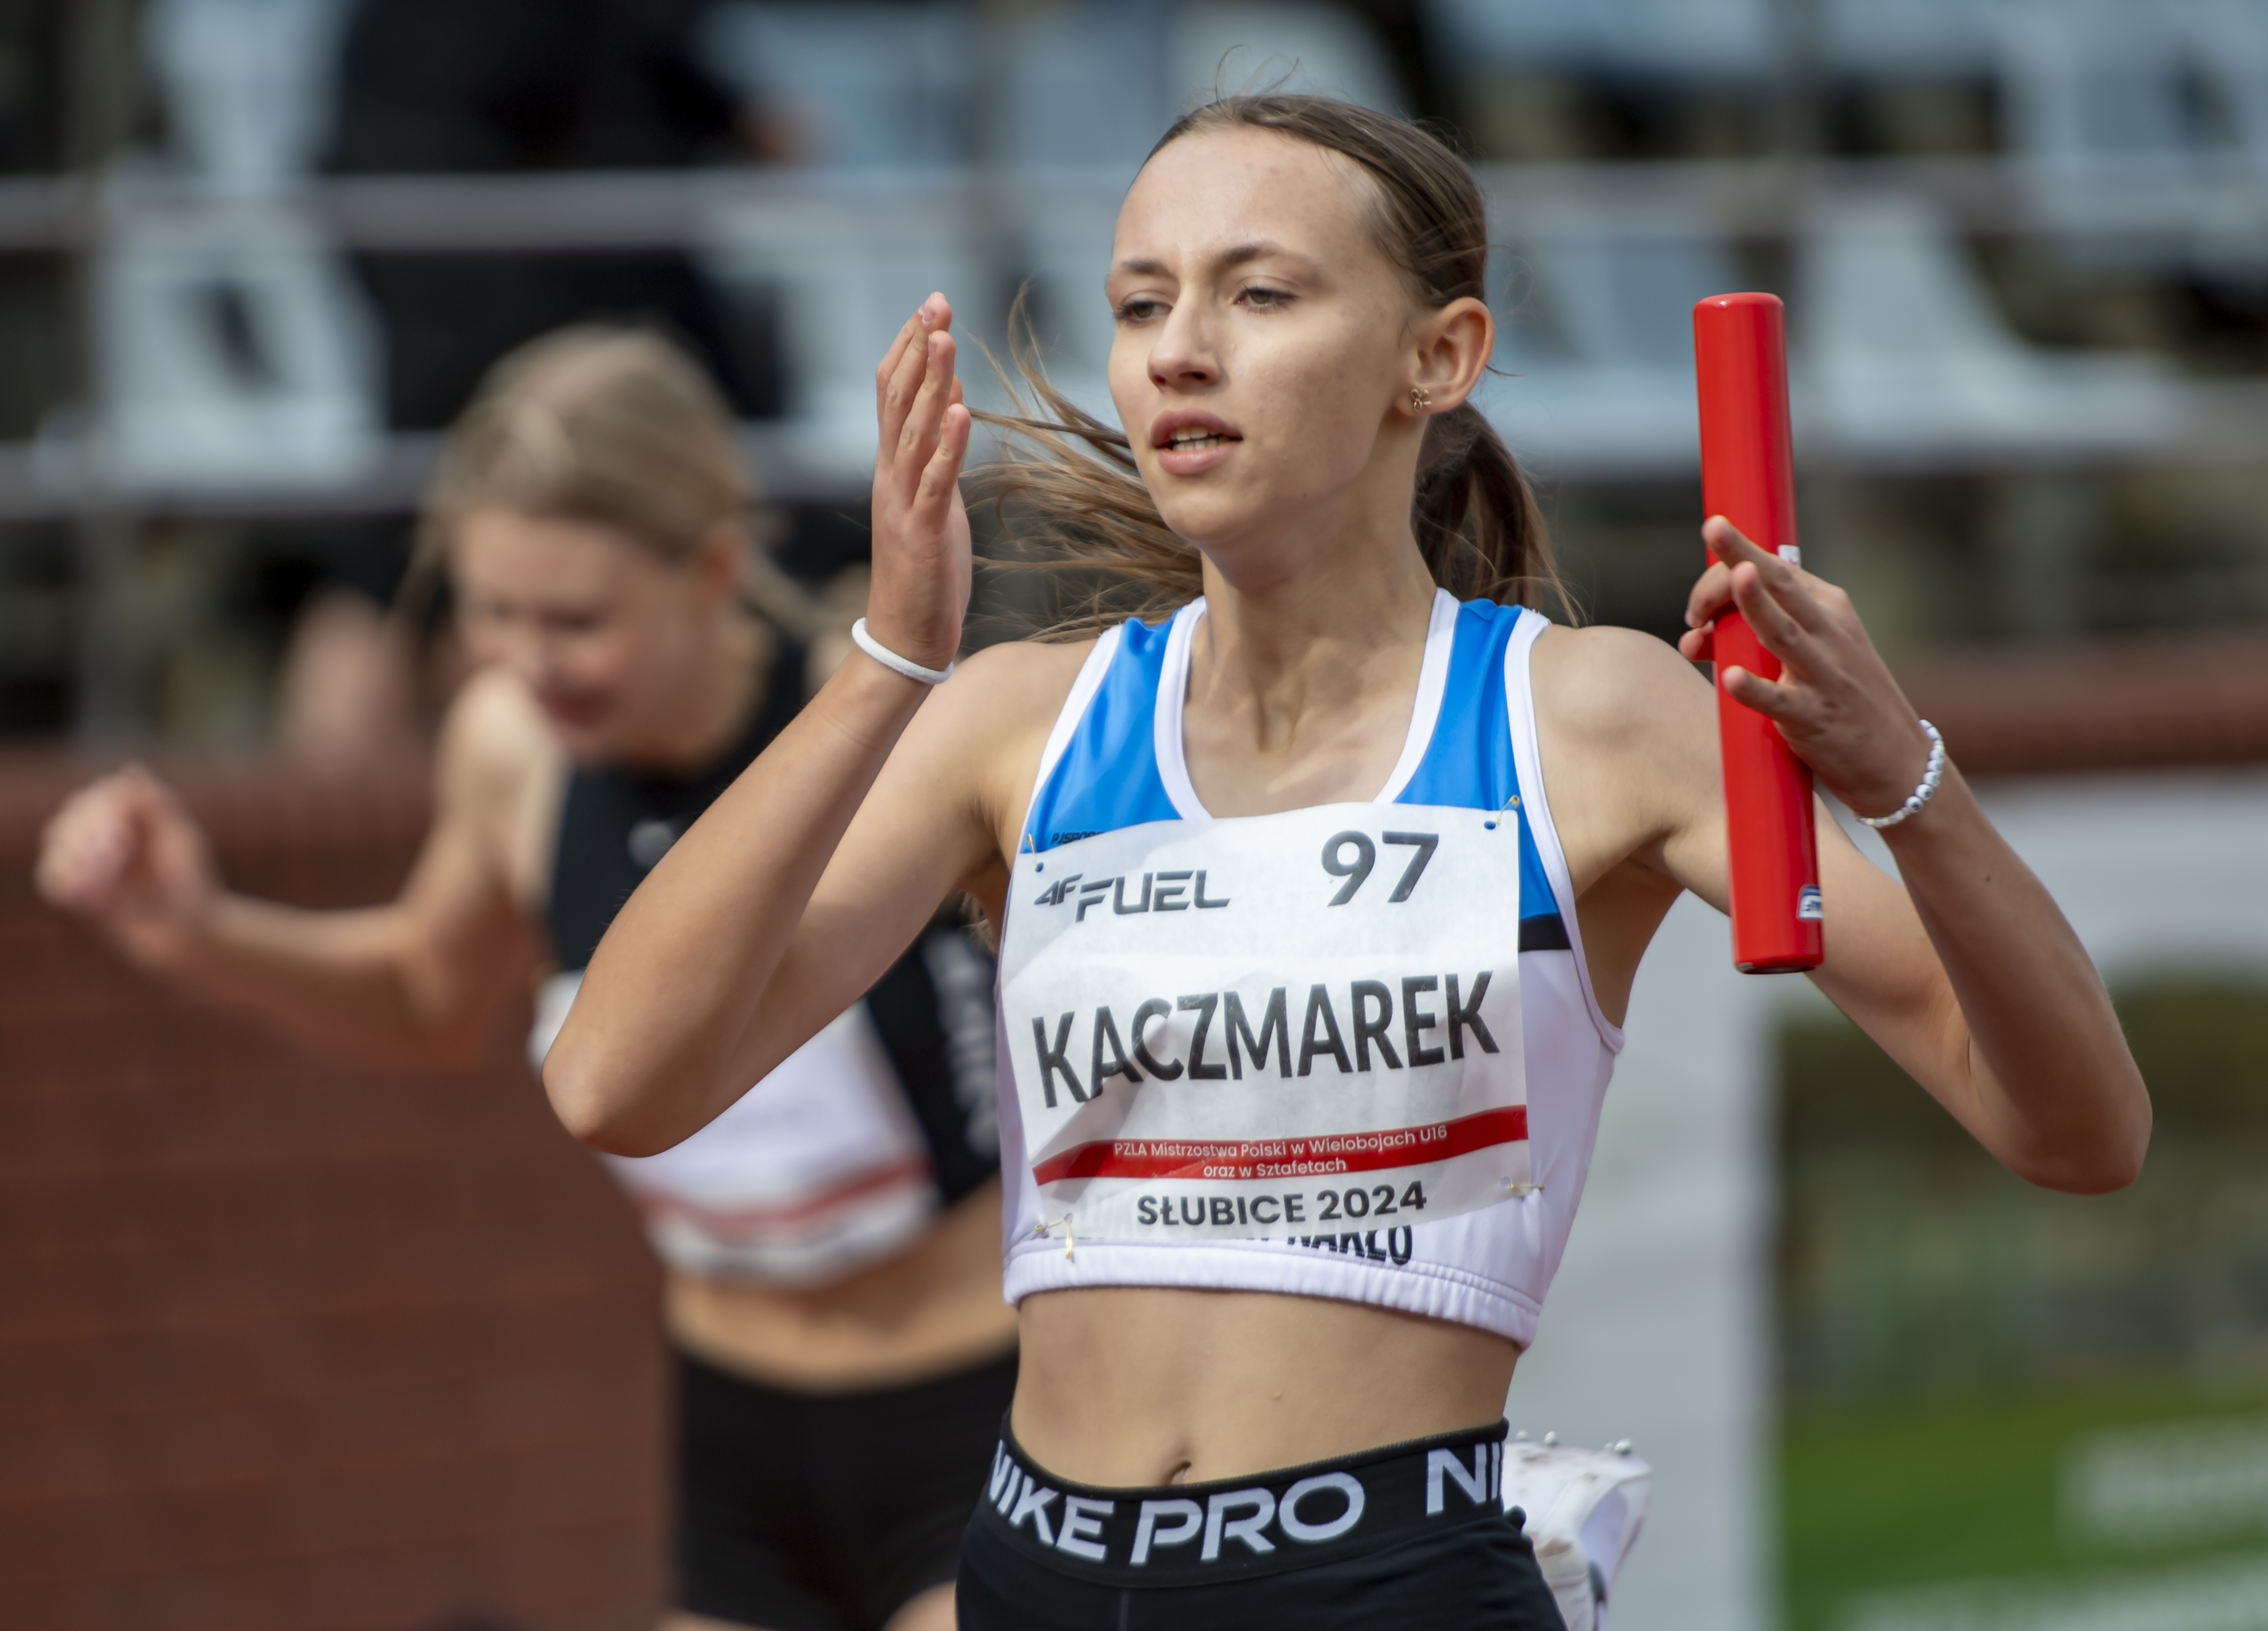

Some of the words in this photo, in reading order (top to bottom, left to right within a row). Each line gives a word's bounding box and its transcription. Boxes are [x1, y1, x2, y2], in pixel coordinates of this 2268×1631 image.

[1321, 830, 1439, 907] 97
[1033, 873, 1084, 906] 4F
[1075, 869, 1231, 924] FUEL
[1031, 969, 1500, 1108] KACZMAREK
[1114, 1142, 1147, 1156] PZLA
[1151, 1141, 1237, 1157] Mistrzostwa
[1241, 1142, 1287, 1157] Polski
[1290, 1142, 1305, 1154] w
[1309, 1131, 1416, 1153] Wielobojach
[1420, 1125, 1447, 1142] U16
[1203, 1165, 1235, 1178] oraz
[1238, 1165, 1252, 1178] w
[1256, 1157, 1347, 1177] Sztafetach
[1137, 1193, 1306, 1225] SŁUBICE
[1316, 1180, 1427, 1221] 2024
[989, 1439, 1115, 1560] NIKE
[1129, 1471, 1365, 1565] PRO
[1426, 1442, 1504, 1514] NI
